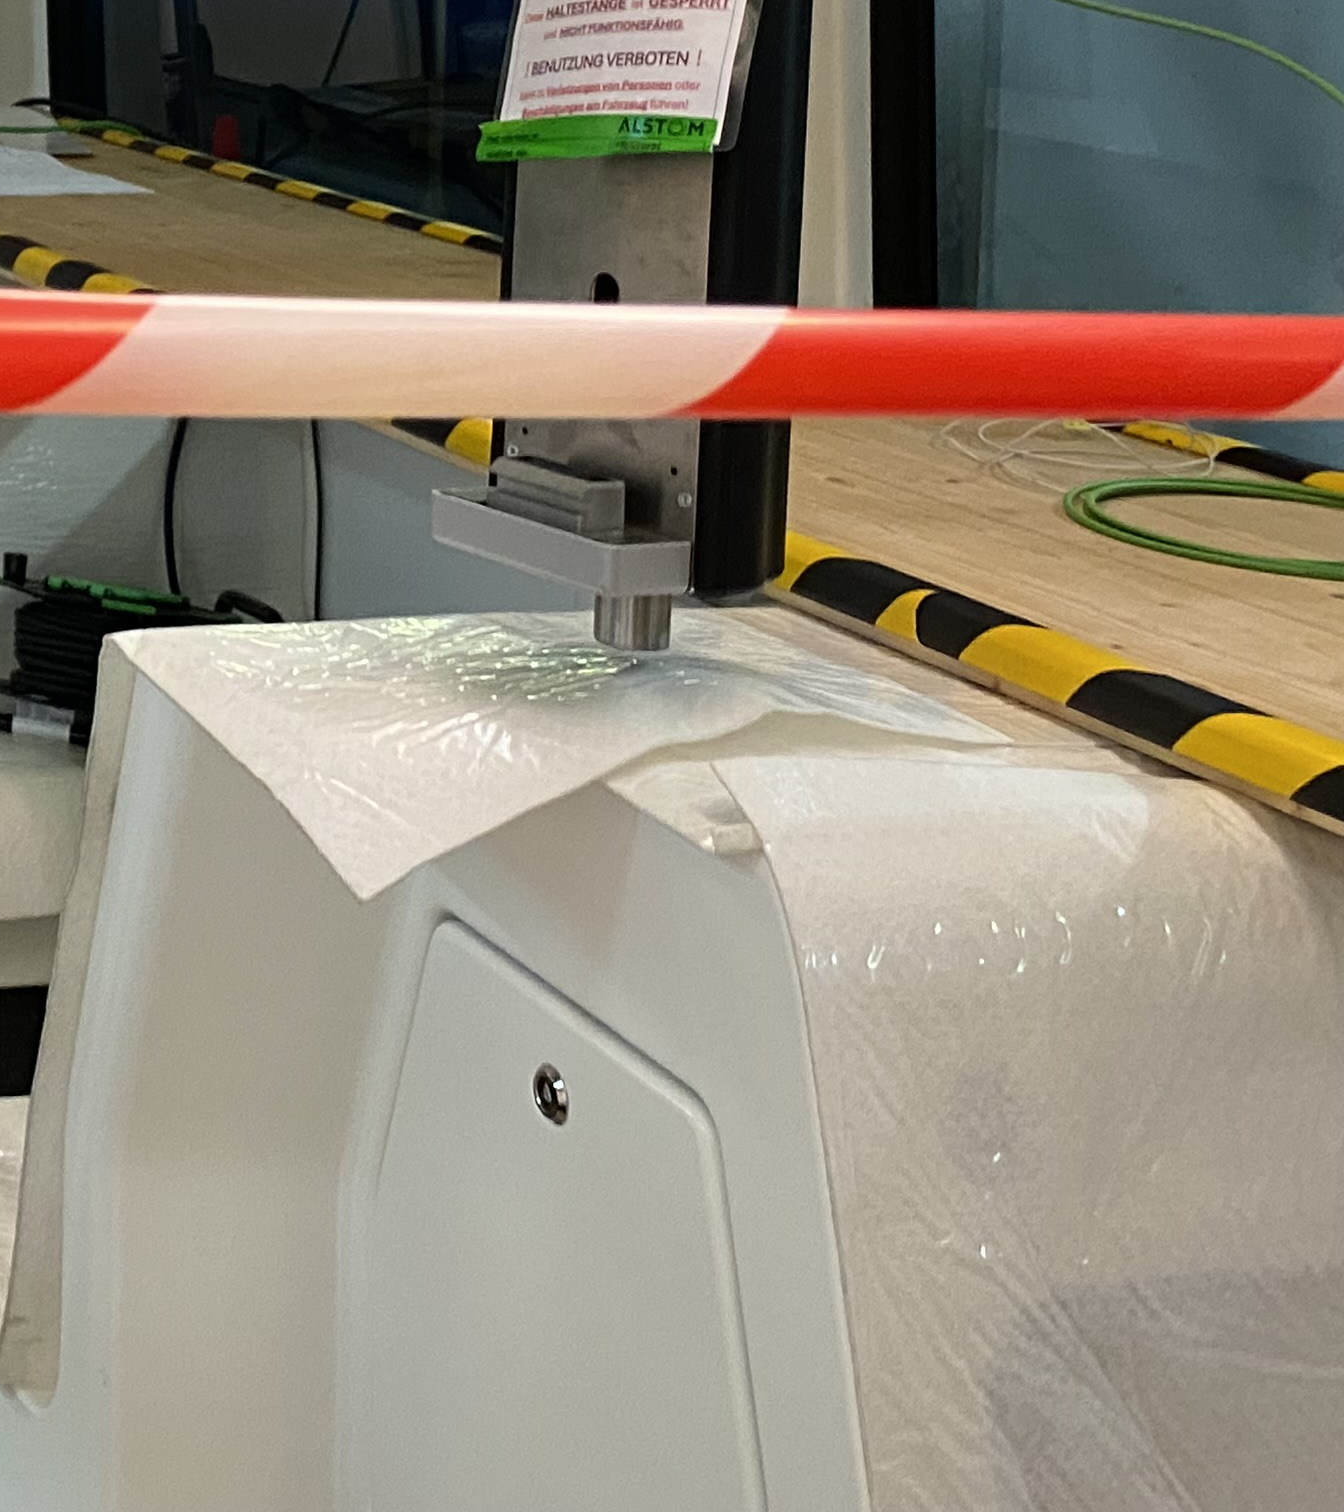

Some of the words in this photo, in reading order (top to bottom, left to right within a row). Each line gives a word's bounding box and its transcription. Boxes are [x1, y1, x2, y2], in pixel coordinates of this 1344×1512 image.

[531, 53, 604, 75] BENUTZUNG
[607, 50, 690, 68] VERBOTEN
[618, 116, 705, 137] ALSTOM
